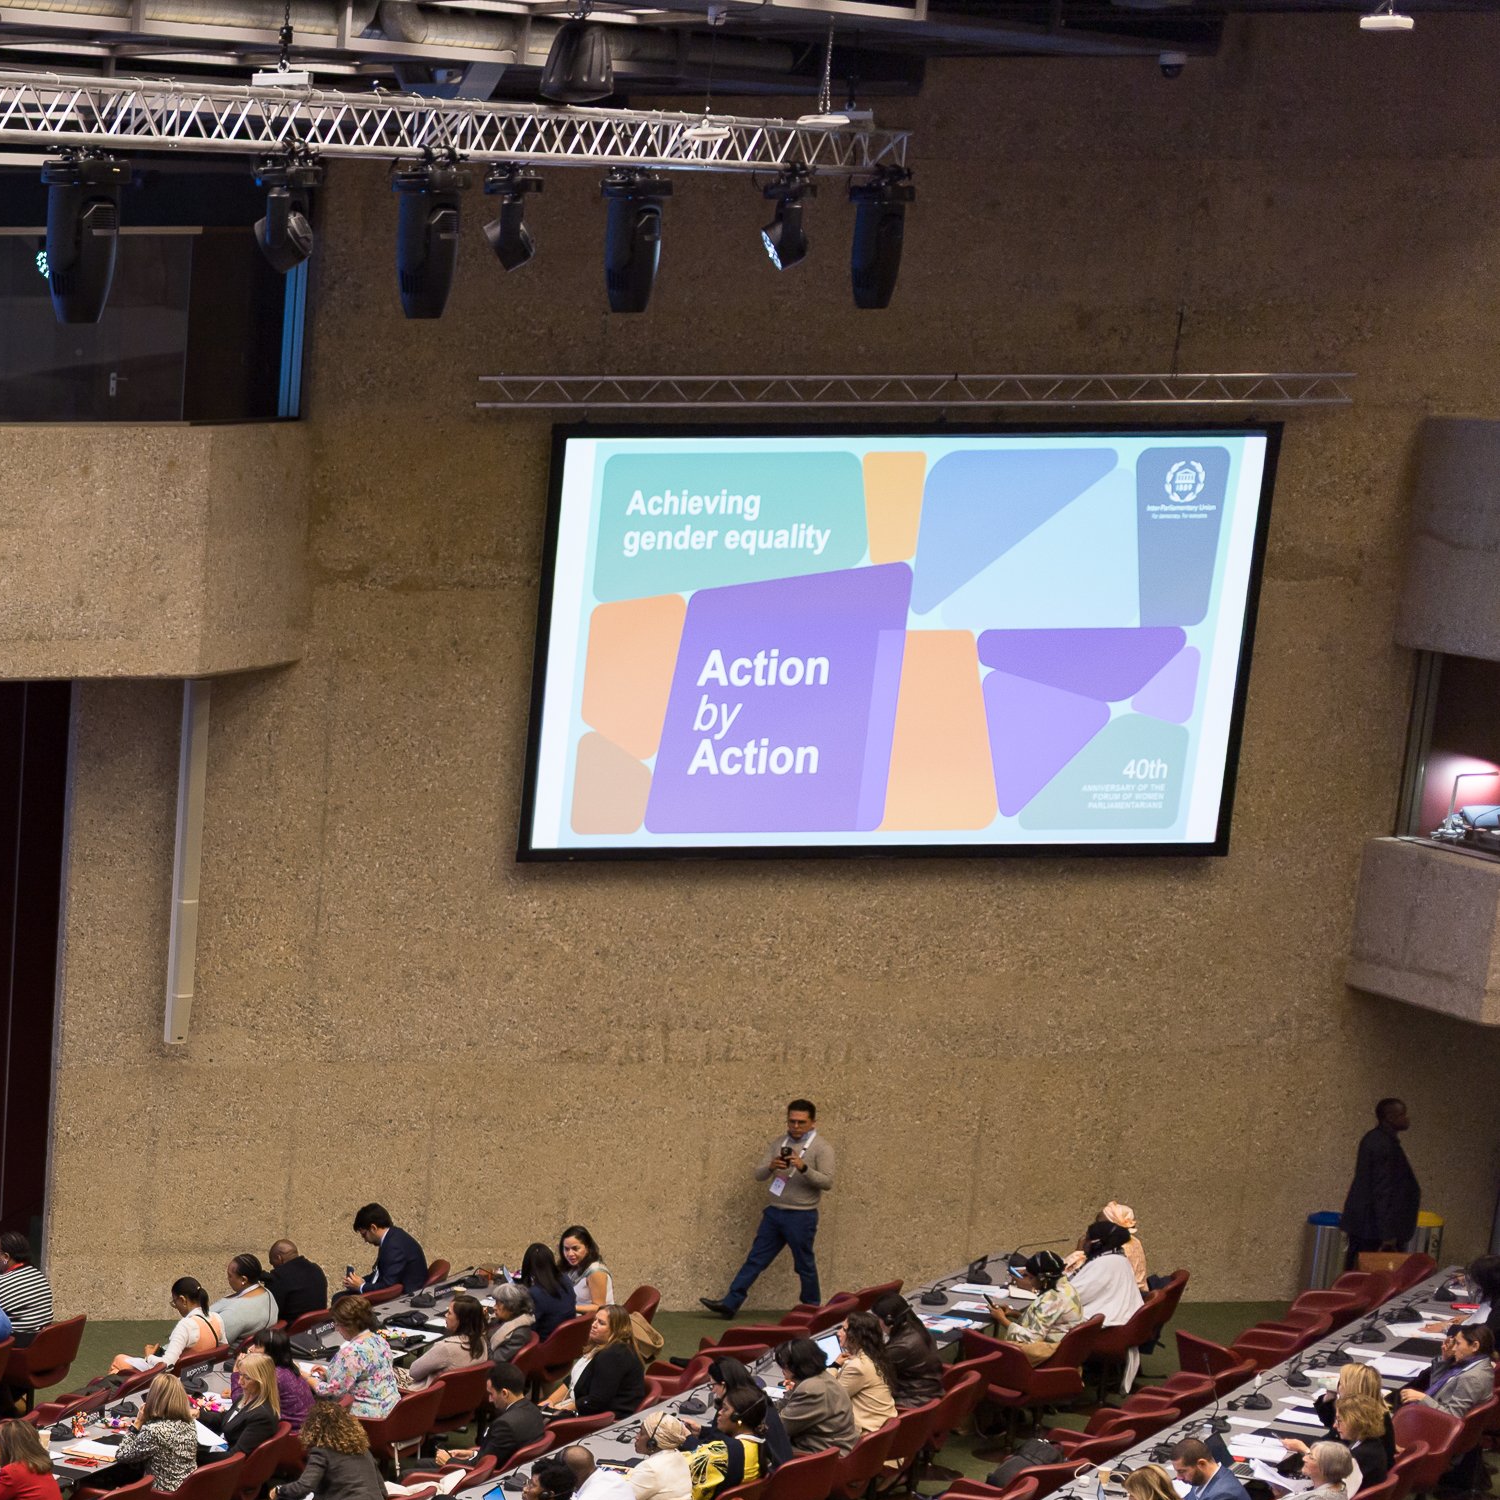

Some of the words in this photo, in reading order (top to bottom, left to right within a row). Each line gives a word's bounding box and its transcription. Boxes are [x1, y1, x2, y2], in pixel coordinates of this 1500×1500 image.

[625, 488, 761, 521] Achieving
[622, 524, 718, 557] gender
[724, 523, 831, 555] equality
[696, 648, 830, 687] Action
[692, 694, 743, 740] by
[686, 737, 819, 775] Action
[1122, 758, 1168, 779] 40th
[1081, 784, 1136, 792] ANNIVERSARY
[1137, 783, 1149, 791] OF
[1150, 783, 1166, 791] THE
[1092, 792, 1121, 800] FORUM
[1121, 792, 1133, 800] OF
[1135, 792, 1165, 800] WOMEN
[1087, 801, 1163, 809] PARLIAMENTARIANS
